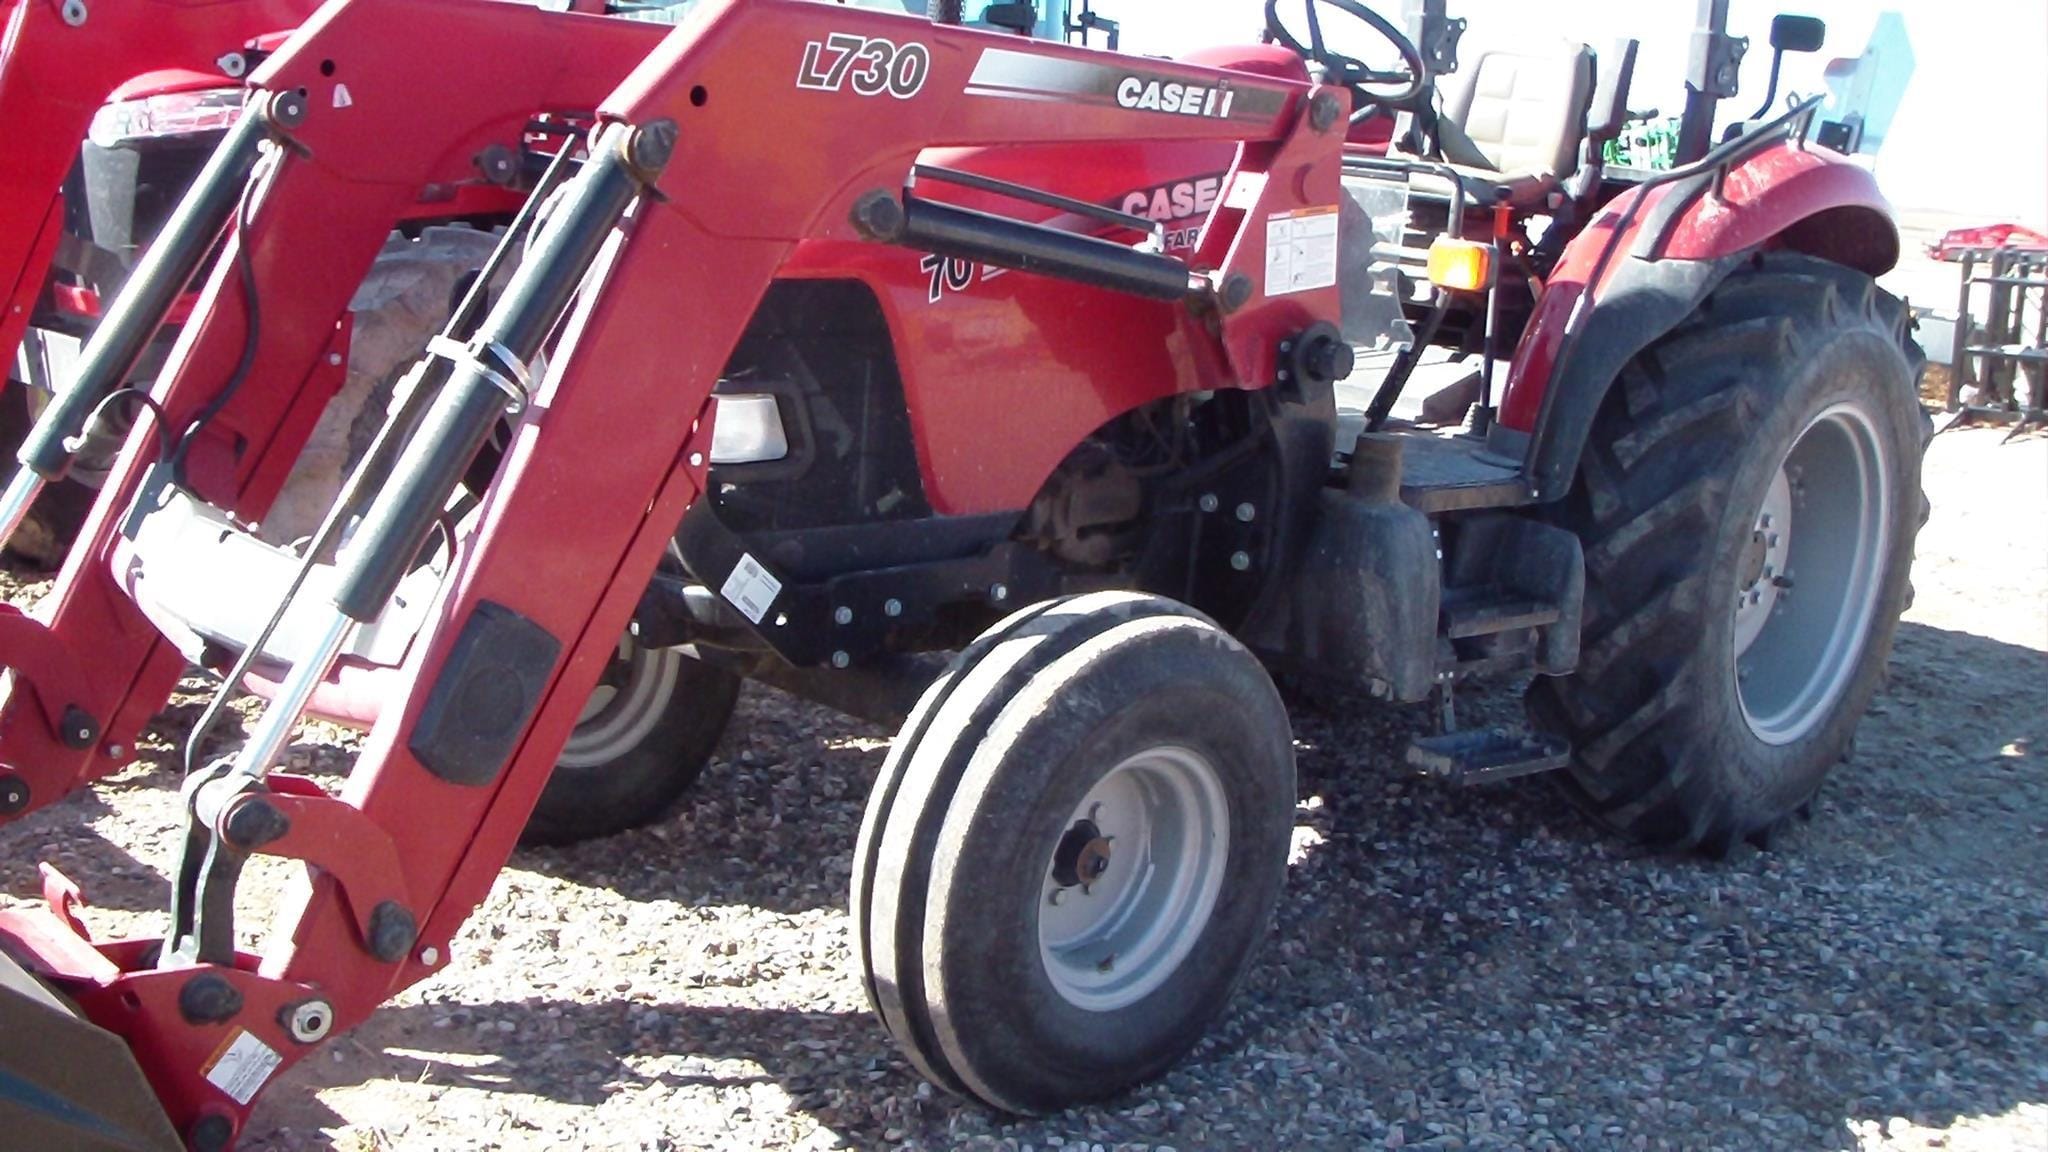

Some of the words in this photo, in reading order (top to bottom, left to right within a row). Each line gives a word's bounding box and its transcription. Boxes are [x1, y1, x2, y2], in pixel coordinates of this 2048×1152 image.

[797, 32, 929, 99] L730
[1122, 177, 1217, 221] CASE
[1164, 227, 1203, 248] FAR
